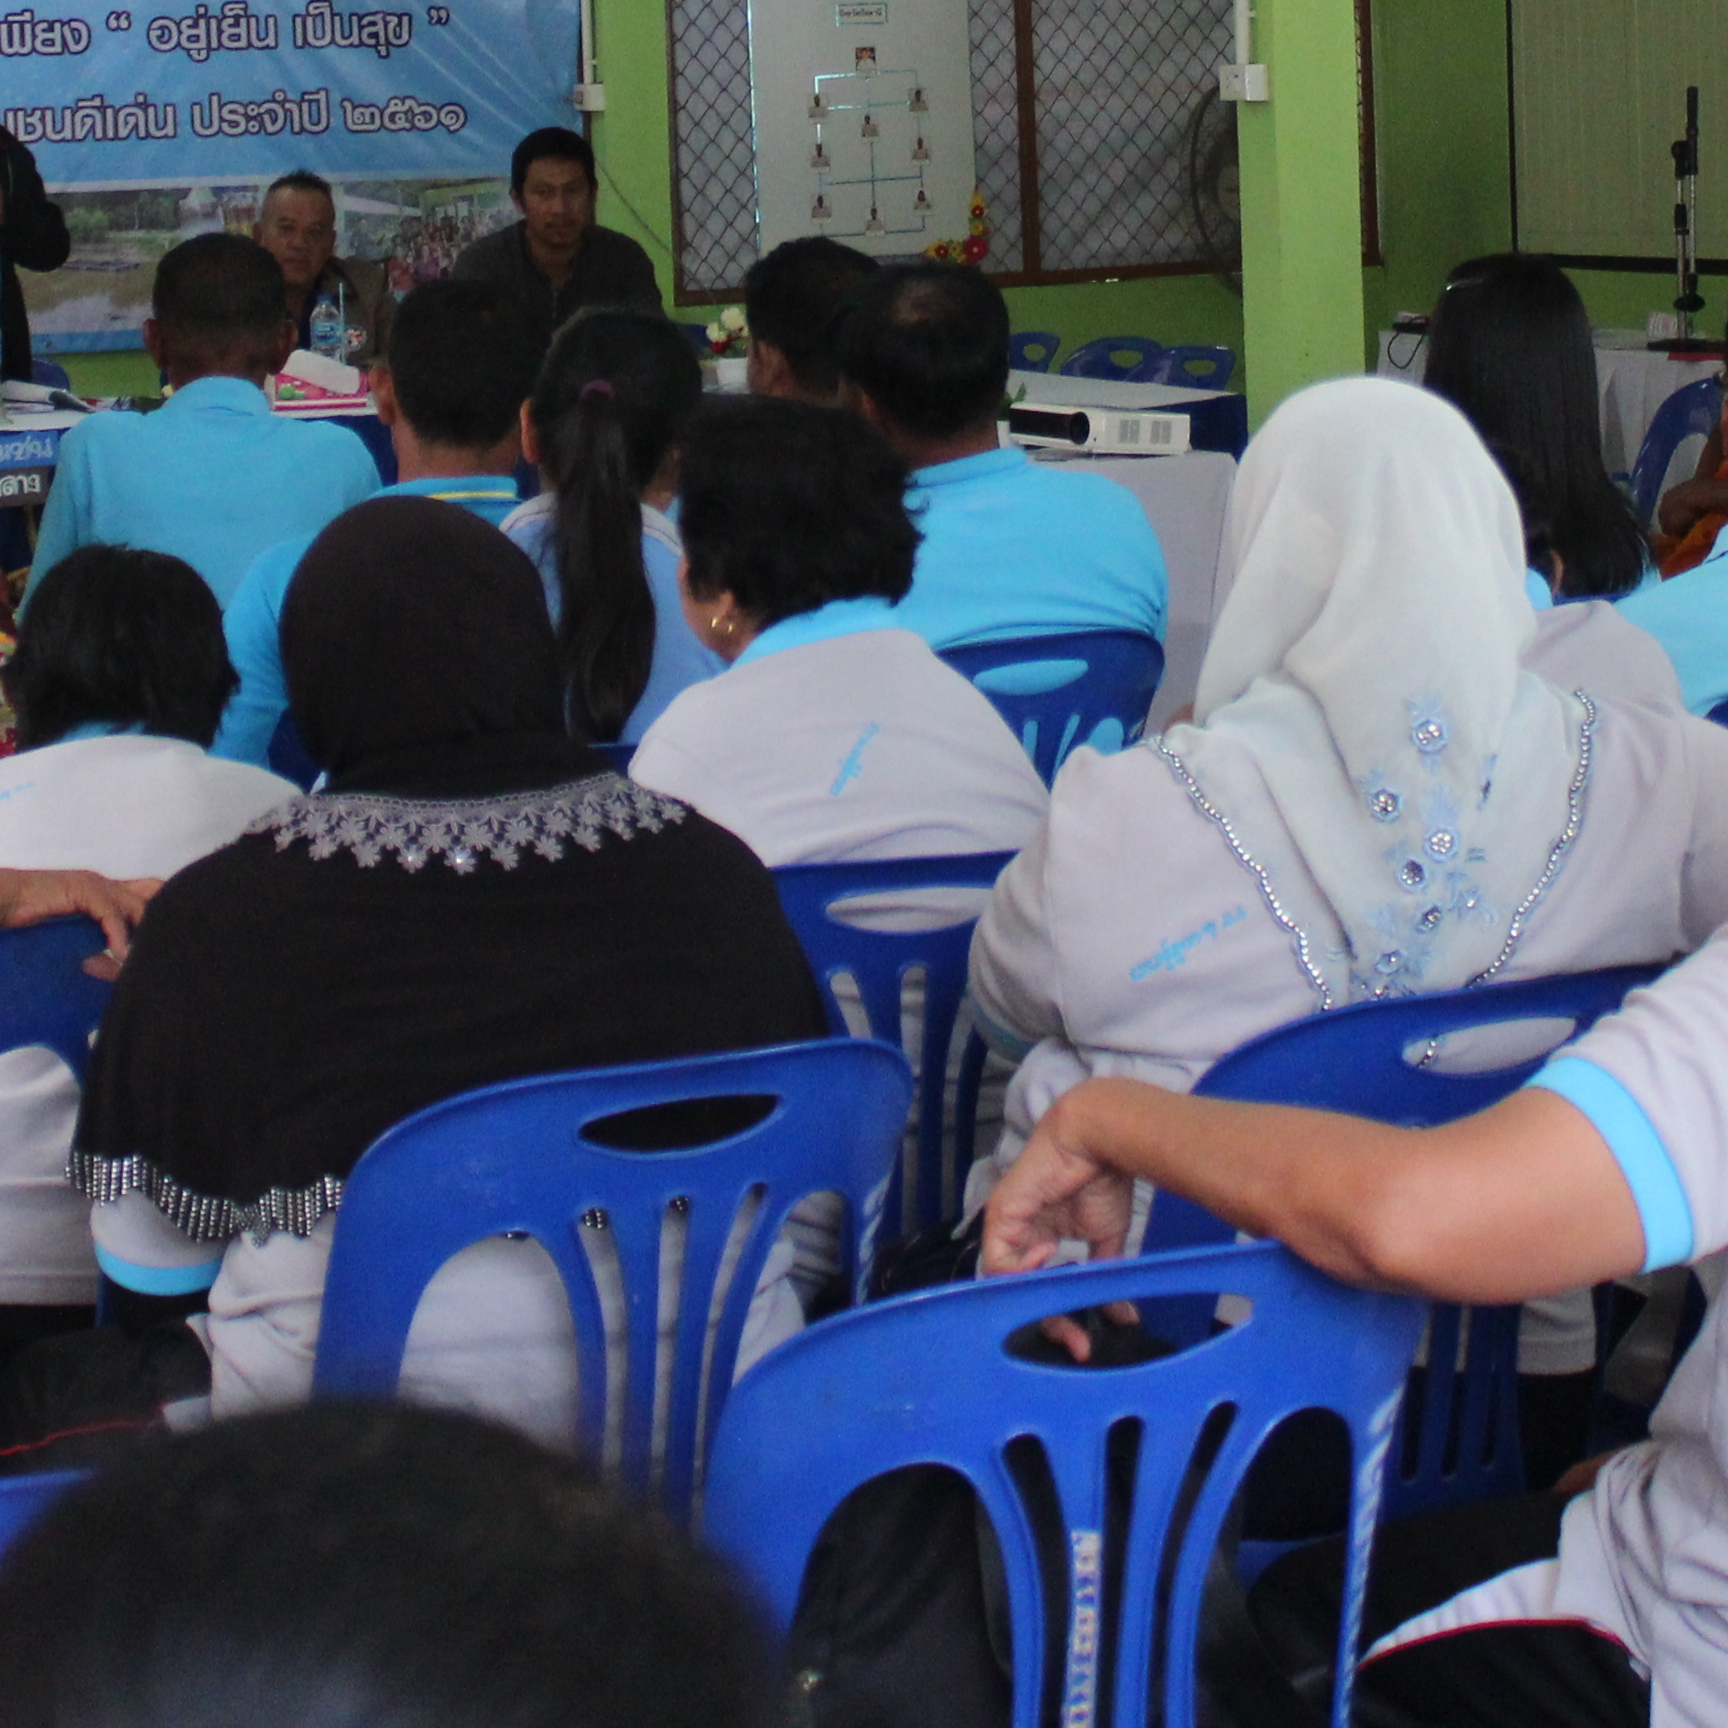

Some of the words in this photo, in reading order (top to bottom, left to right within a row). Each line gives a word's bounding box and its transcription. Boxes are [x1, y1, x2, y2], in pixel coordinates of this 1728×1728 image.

[146, 0, 276, 62] อยู่เย็น
[293, 0, 413, 59] เป็นสุข
[192, 89, 329, 137] ประจำปี
[339, 96, 468, 134] ๒๕๖๑
